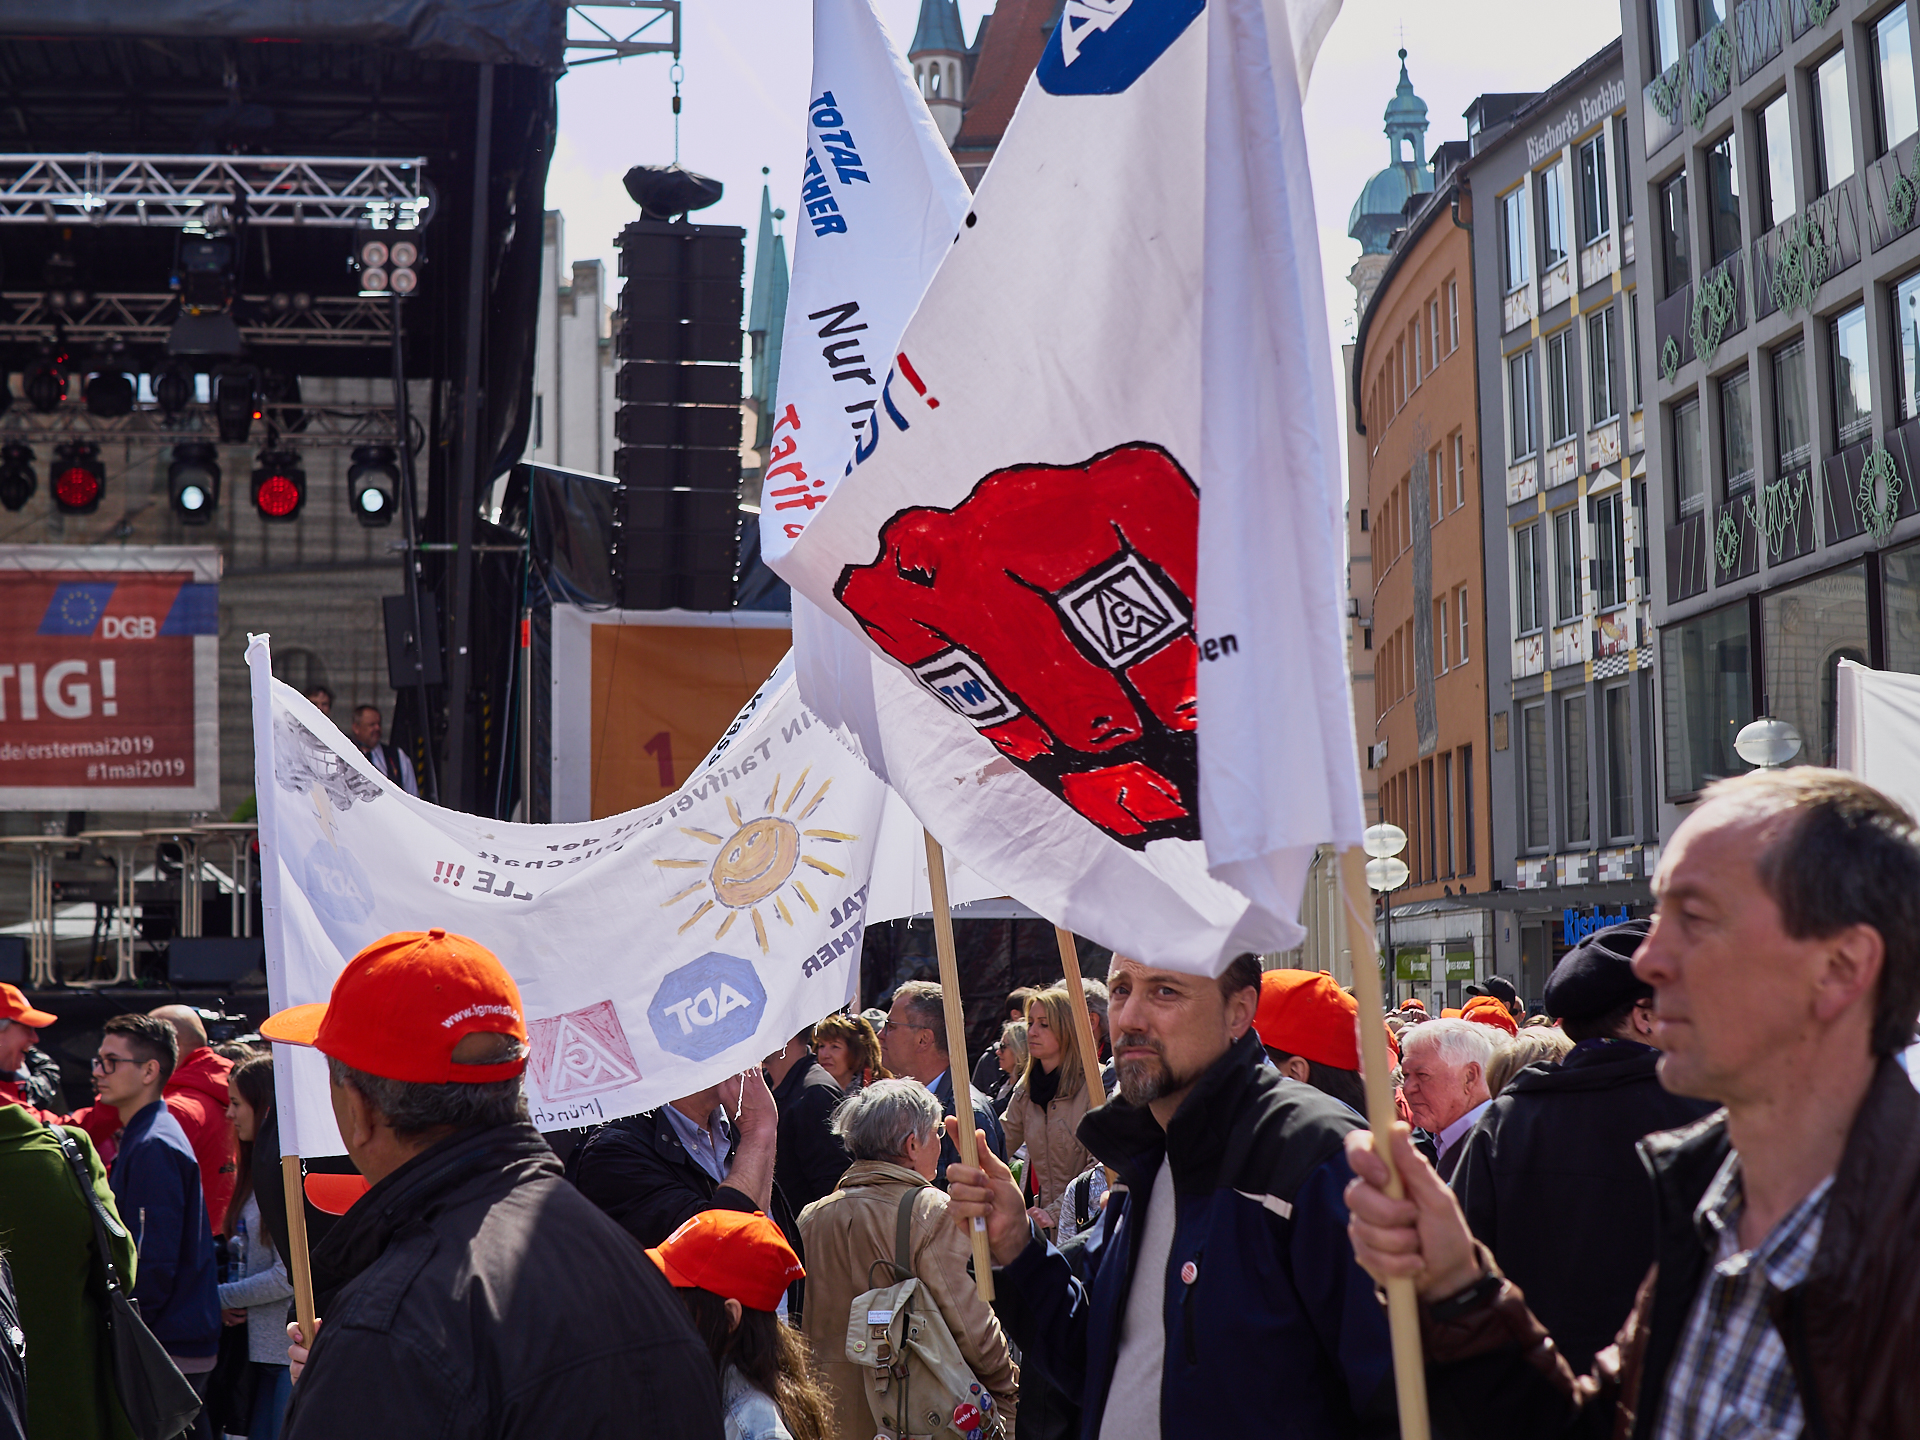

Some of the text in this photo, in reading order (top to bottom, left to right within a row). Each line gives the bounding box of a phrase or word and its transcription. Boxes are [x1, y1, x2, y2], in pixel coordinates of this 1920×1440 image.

[809, 90, 871, 185] TOTAL
[802, 148, 848, 237] THER
[808, 301, 876, 385] Nur
[766, 403, 828, 511] Tarif
[102, 616, 157, 640] DGB
[86, 758, 186, 781] #1mai2019
[643, 731, 675, 788] 1
[956, 1413, 971, 1425] wehr
